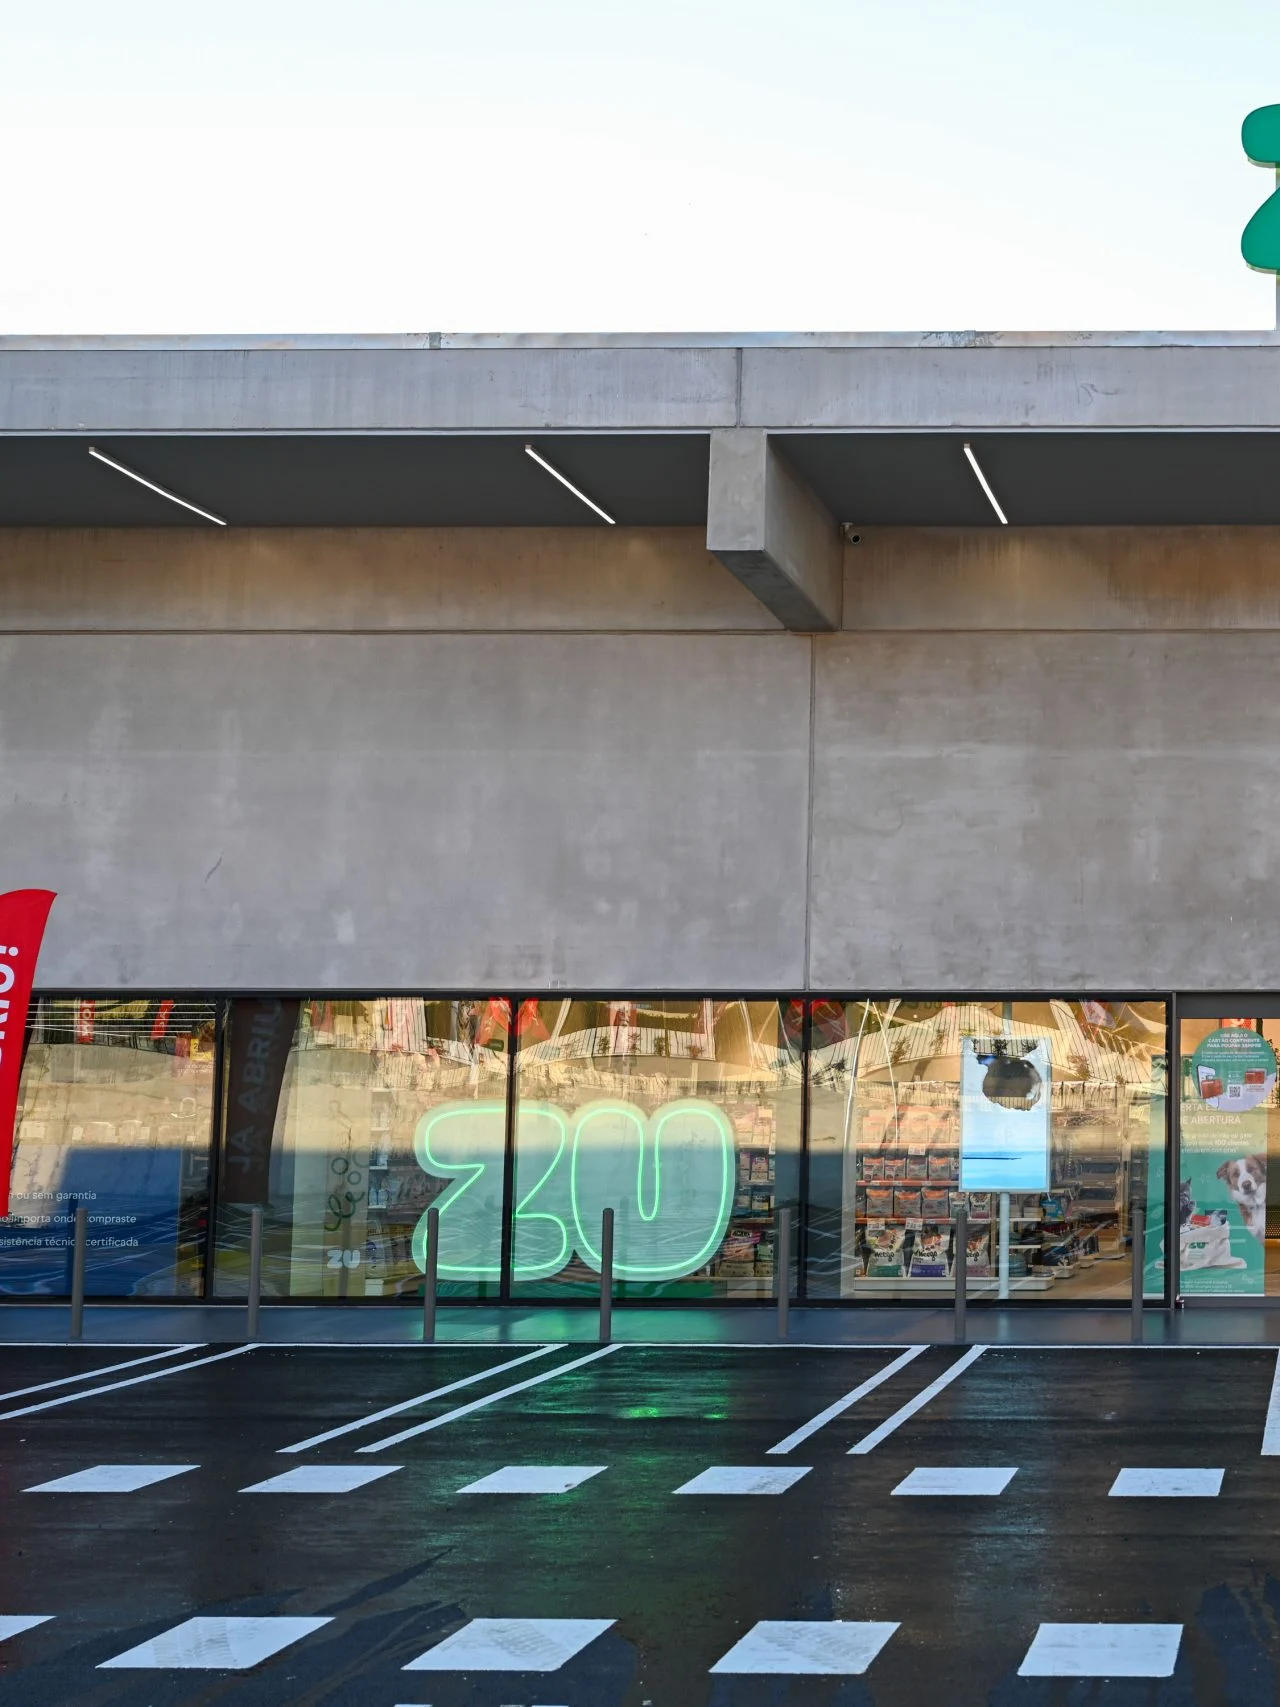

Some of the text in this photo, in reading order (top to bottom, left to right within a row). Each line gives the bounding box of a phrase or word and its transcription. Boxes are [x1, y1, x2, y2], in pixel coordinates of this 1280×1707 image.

[1190, 1115, 1241, 1125] ABERTURA
[411, 1098, 736, 1281] ZU
[16, 1192, 30, 1200] ou
[32, 1192, 53, 1200] sem
[56, 1190, 97, 1202] garantia
[11, 1213, 51, 1224] importa
[45, 1236, 76, 1246] técnic
[85, 1236, 139, 1247] certificada
[326, 1249, 361, 1269] ZU
